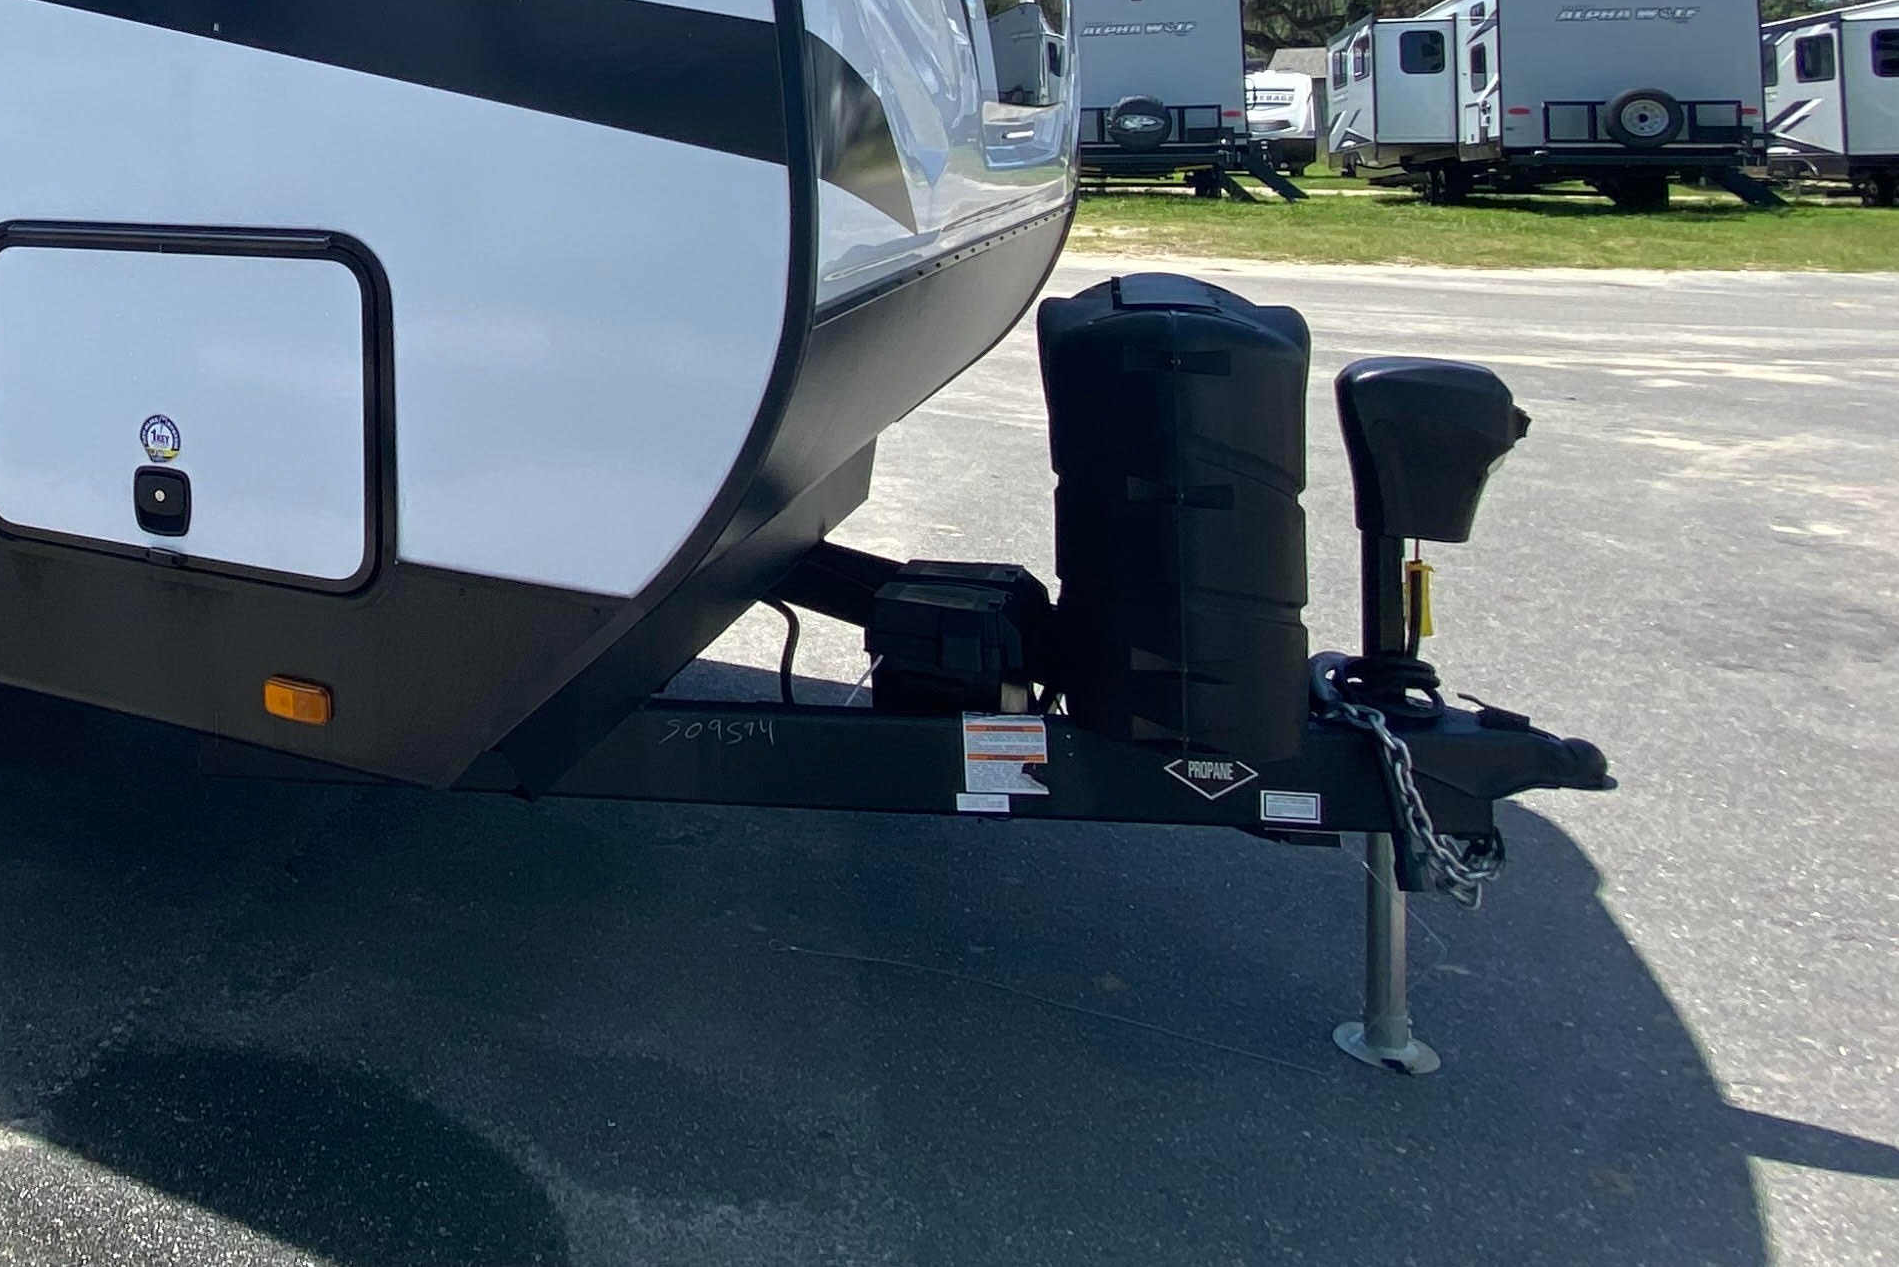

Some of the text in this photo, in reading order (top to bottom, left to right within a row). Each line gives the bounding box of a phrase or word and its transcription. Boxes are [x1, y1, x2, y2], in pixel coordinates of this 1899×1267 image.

[1555, 7, 1632, 22] ALPHA
[1080, 24, 1141, 37] ALPHA
[1188, 760, 1234, 780] PROPANE
